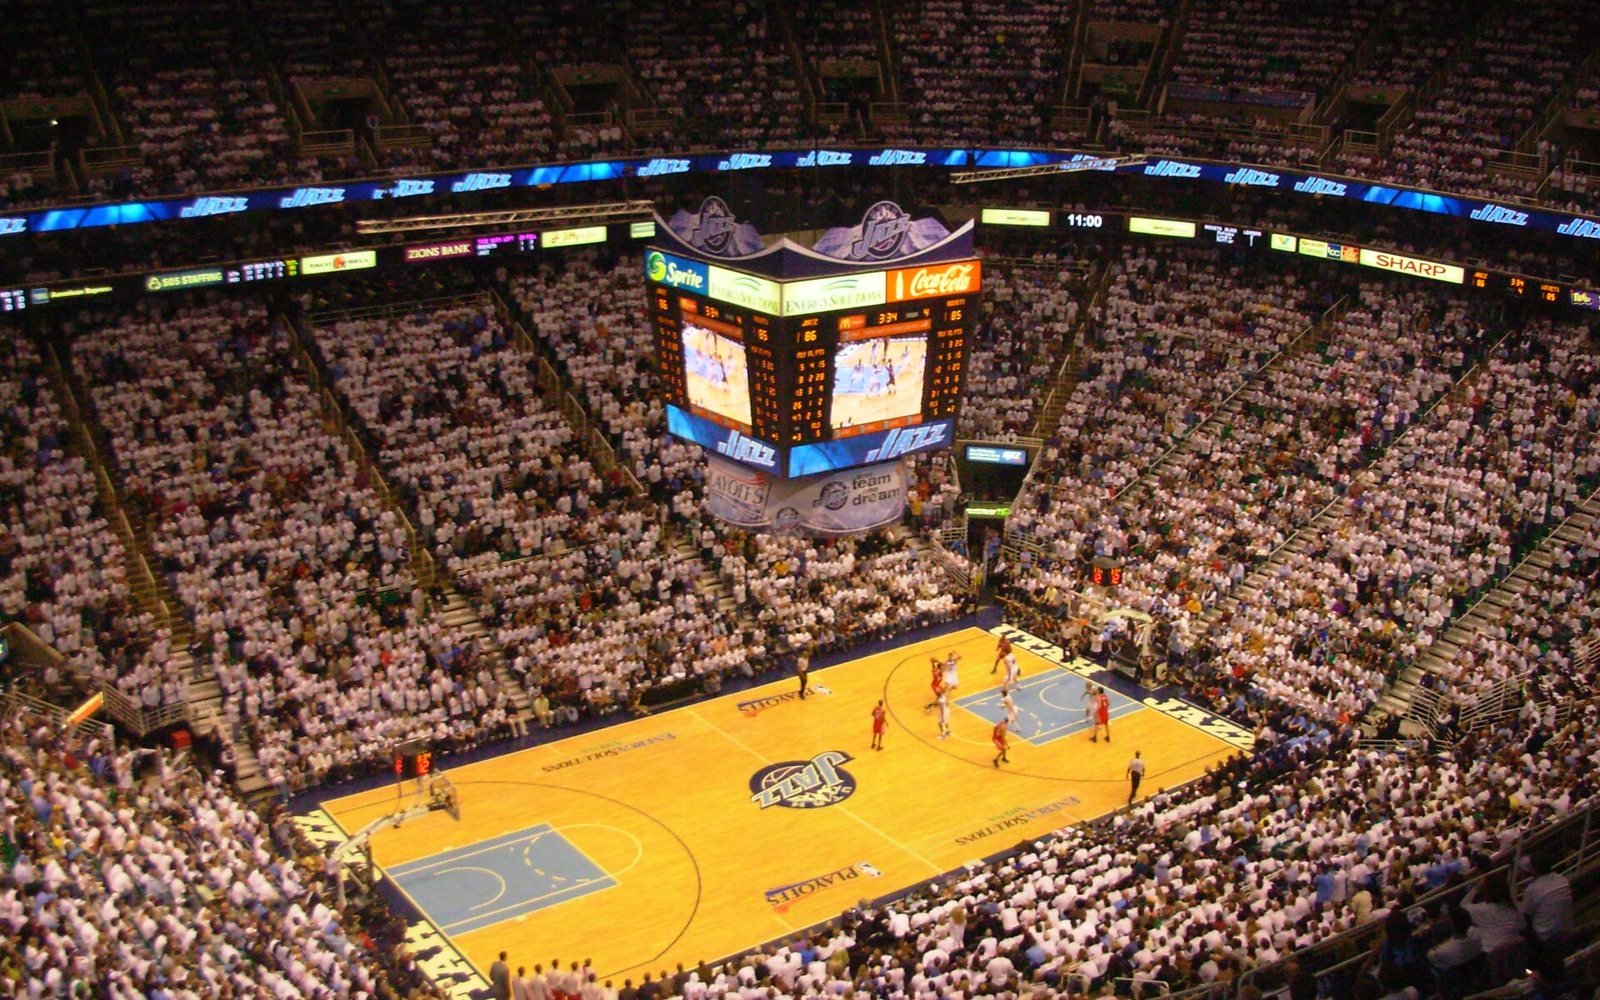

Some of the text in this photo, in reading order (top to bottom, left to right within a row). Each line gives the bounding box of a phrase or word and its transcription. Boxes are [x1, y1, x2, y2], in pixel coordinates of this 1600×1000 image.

[718, 154, 772, 171] JAZZ
[796, 150, 852, 167] JAZZ
[869, 149, 926, 166] JAZZ
[637, 159, 690, 177] JAZZ
[1144, 160, 1201, 178] JAZZ
[452, 173, 512, 193] JAZZ
[1224, 168, 1279, 187] JAZZ
[1294, 176, 1347, 196] JAZZ
[280, 188, 346, 208] JAZZ
[180, 197, 248, 218] JAZZ
[1470, 204, 1528, 226] JAZZ
[1067, 213, 1102, 227] 11:00
[408, 243, 471, 259] ZIONS BANK
[1376, 254, 1446, 277] SHARP
[162, 276, 181, 287] SOS
[182, 272, 222, 285] STAFFING
[667, 262, 704, 288] Sprite
[879, 312, 898, 324] 3:34
[923, 308, 930, 317] 4
[951, 310, 962, 320] 85
[804, 331, 817, 342] 86
[717, 429, 776, 467] JAZZ
[865, 422, 948, 463] JAZZ
[852, 473, 891, 490] team
[852, 487, 900, 507] dream
[751, 750, 856, 810] JAZZ
[766, 864, 859, 907] PLAYOFFS
